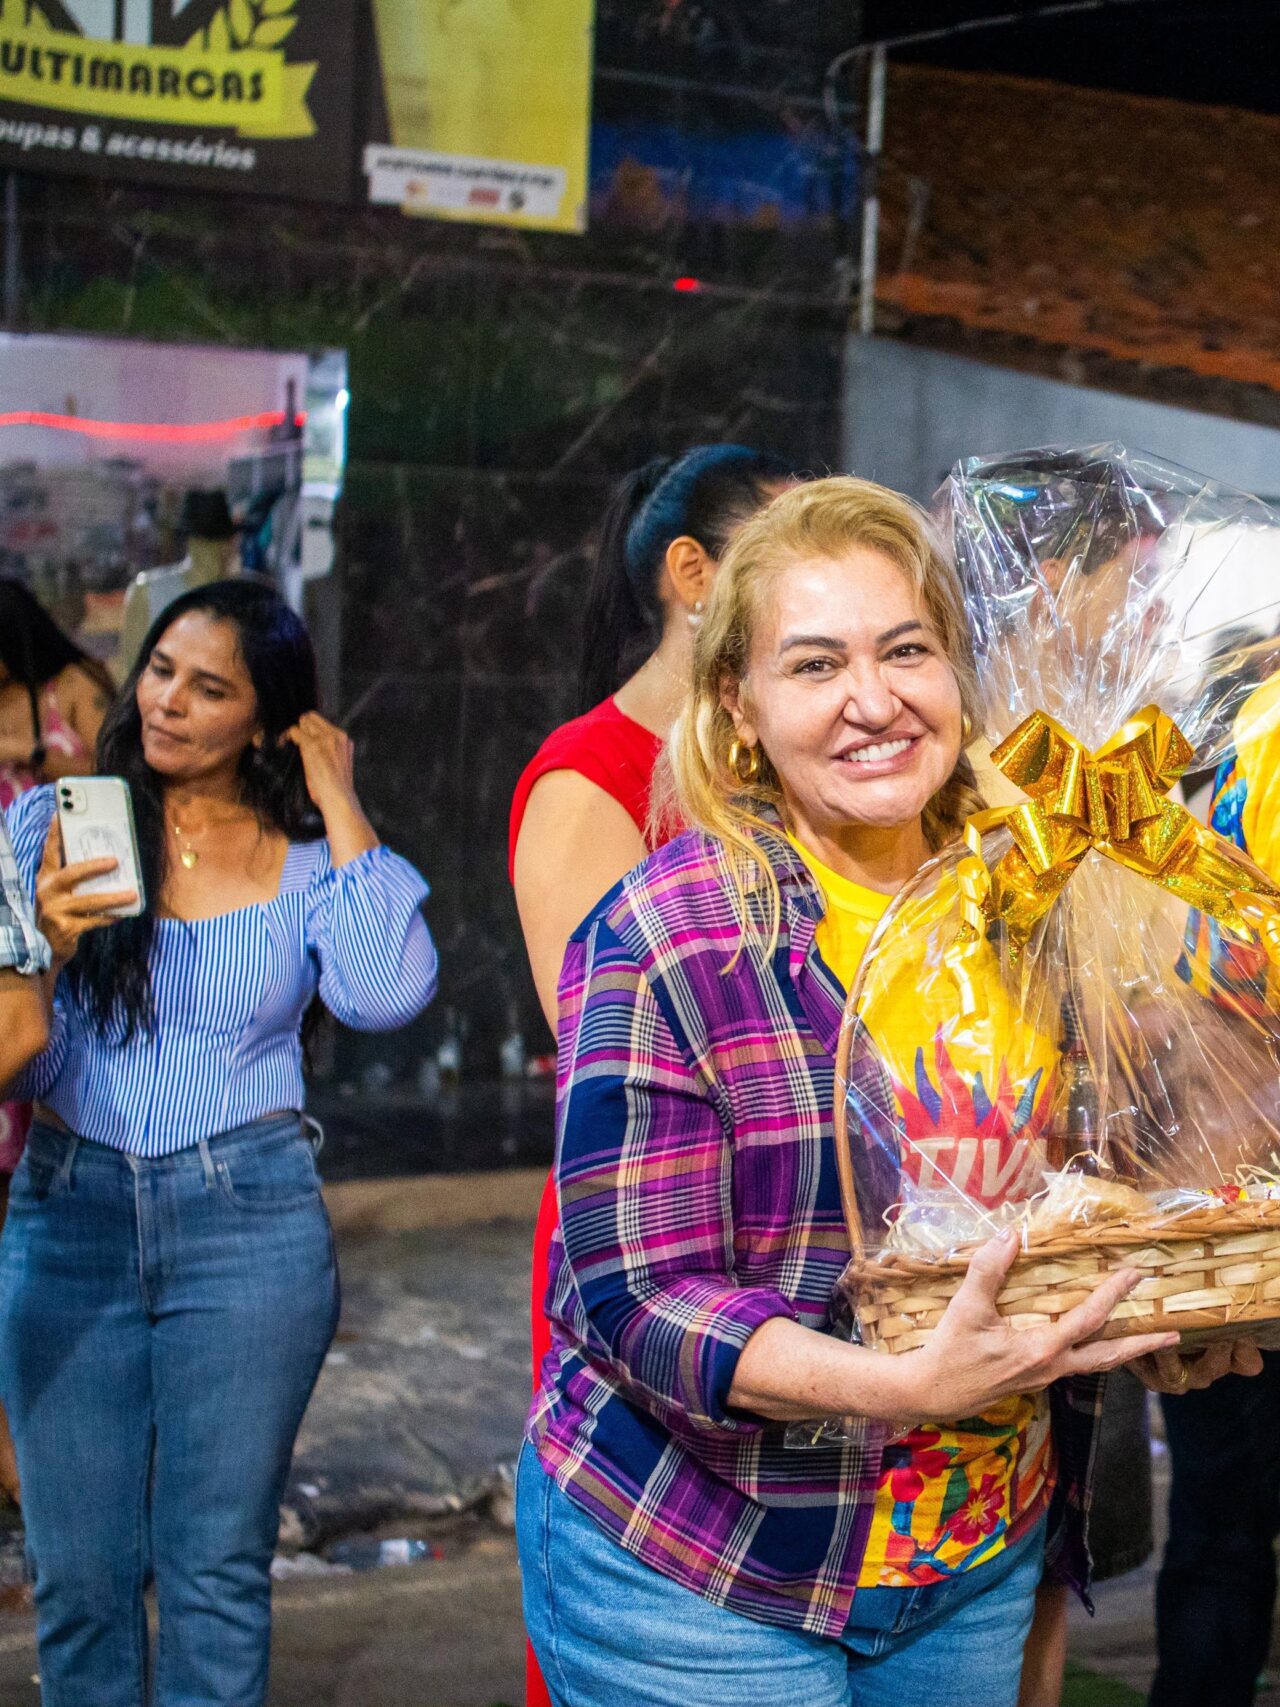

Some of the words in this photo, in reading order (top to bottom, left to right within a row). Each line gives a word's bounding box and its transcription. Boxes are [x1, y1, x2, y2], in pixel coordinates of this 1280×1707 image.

[0, 40, 264, 102] ULTIMARCAS
[0, 119, 76, 151] oupas
[80, 125, 100, 153] &
[105, 133, 256, 170] acessórios
